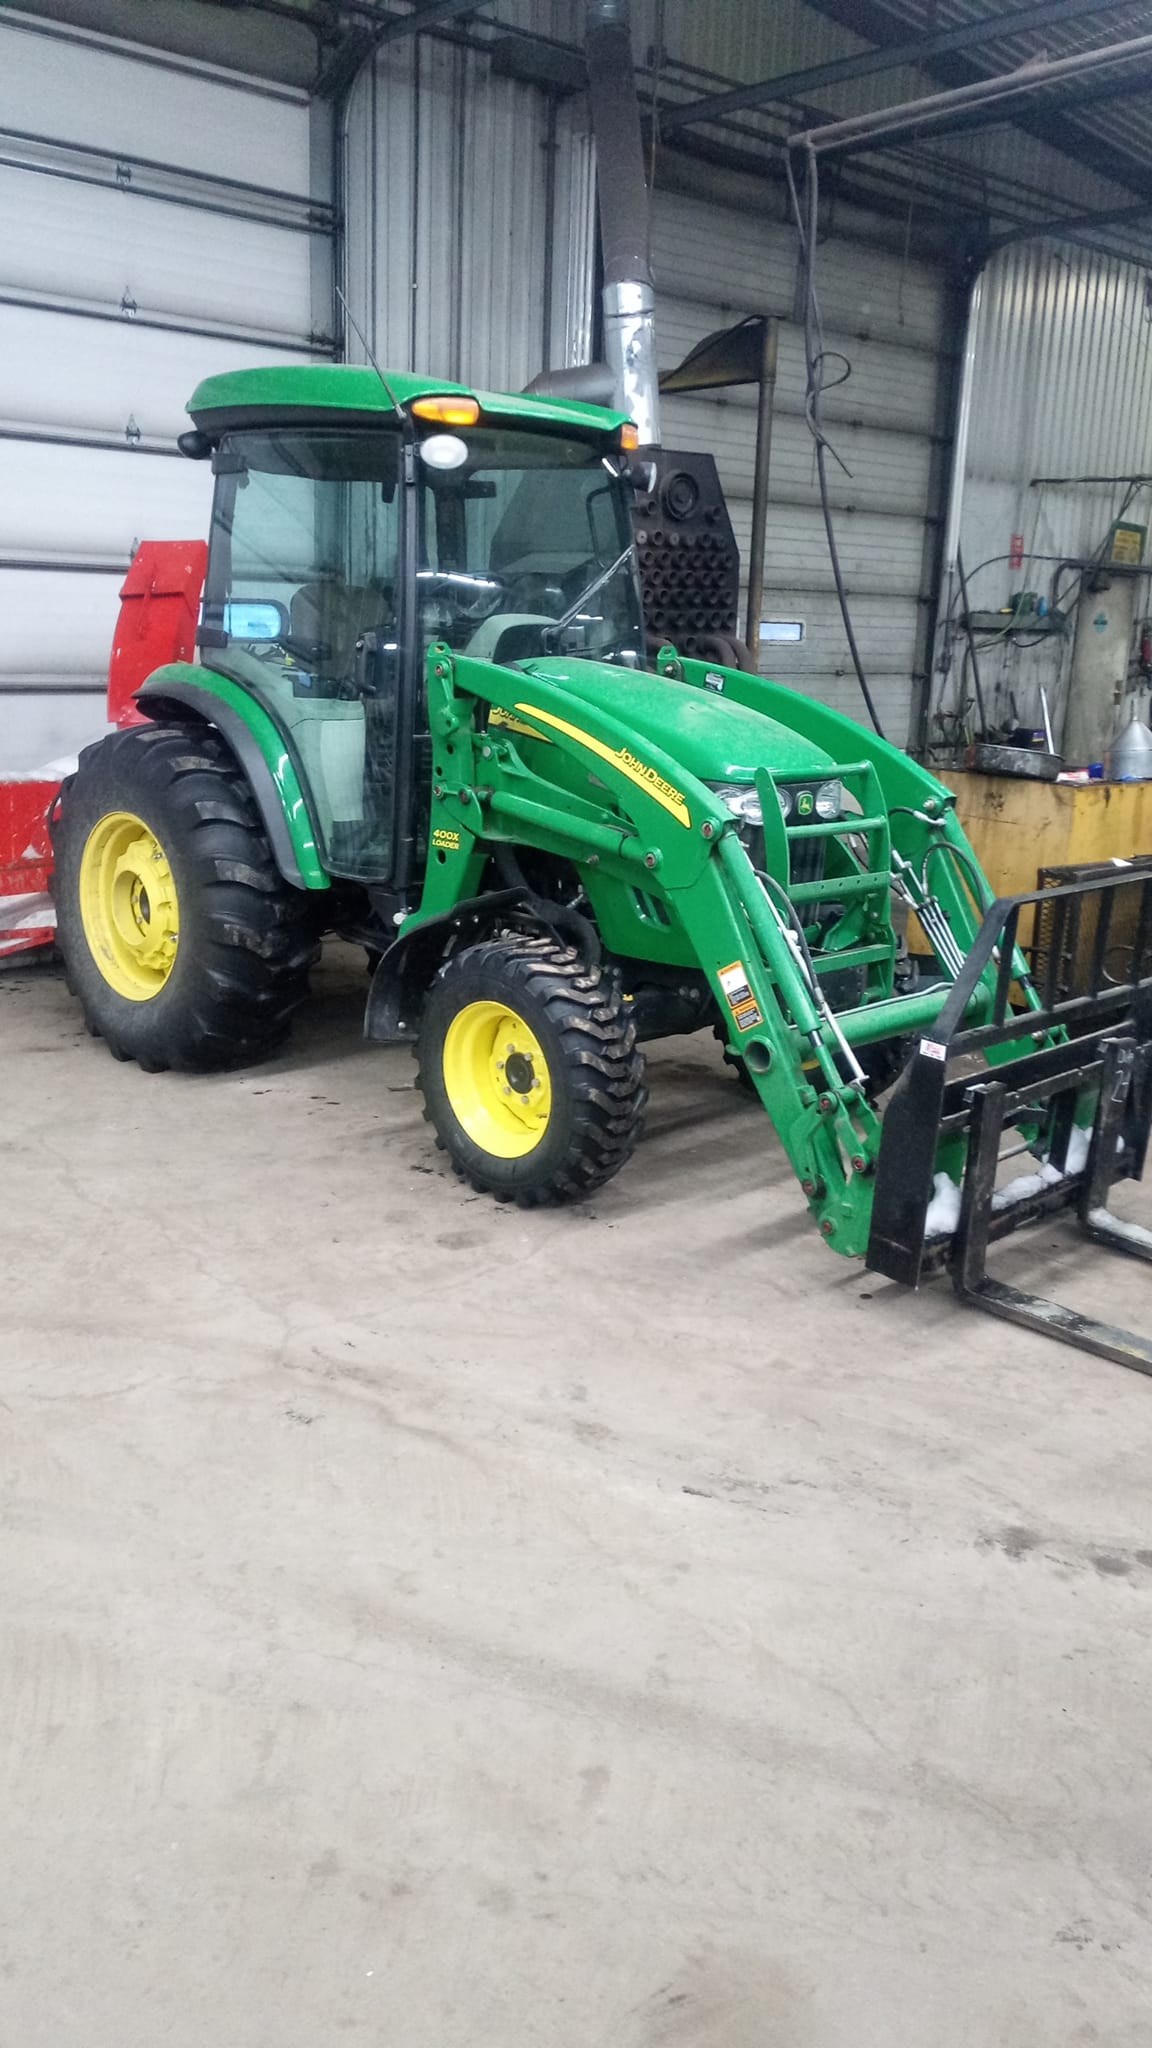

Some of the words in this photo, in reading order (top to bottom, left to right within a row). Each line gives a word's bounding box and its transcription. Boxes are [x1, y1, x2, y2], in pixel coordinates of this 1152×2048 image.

[615, 747, 648, 777] JOHN
[644, 768, 686, 806] DEERE
[433, 829, 460, 841] 400X
[432, 838, 460, 850] LOADER
